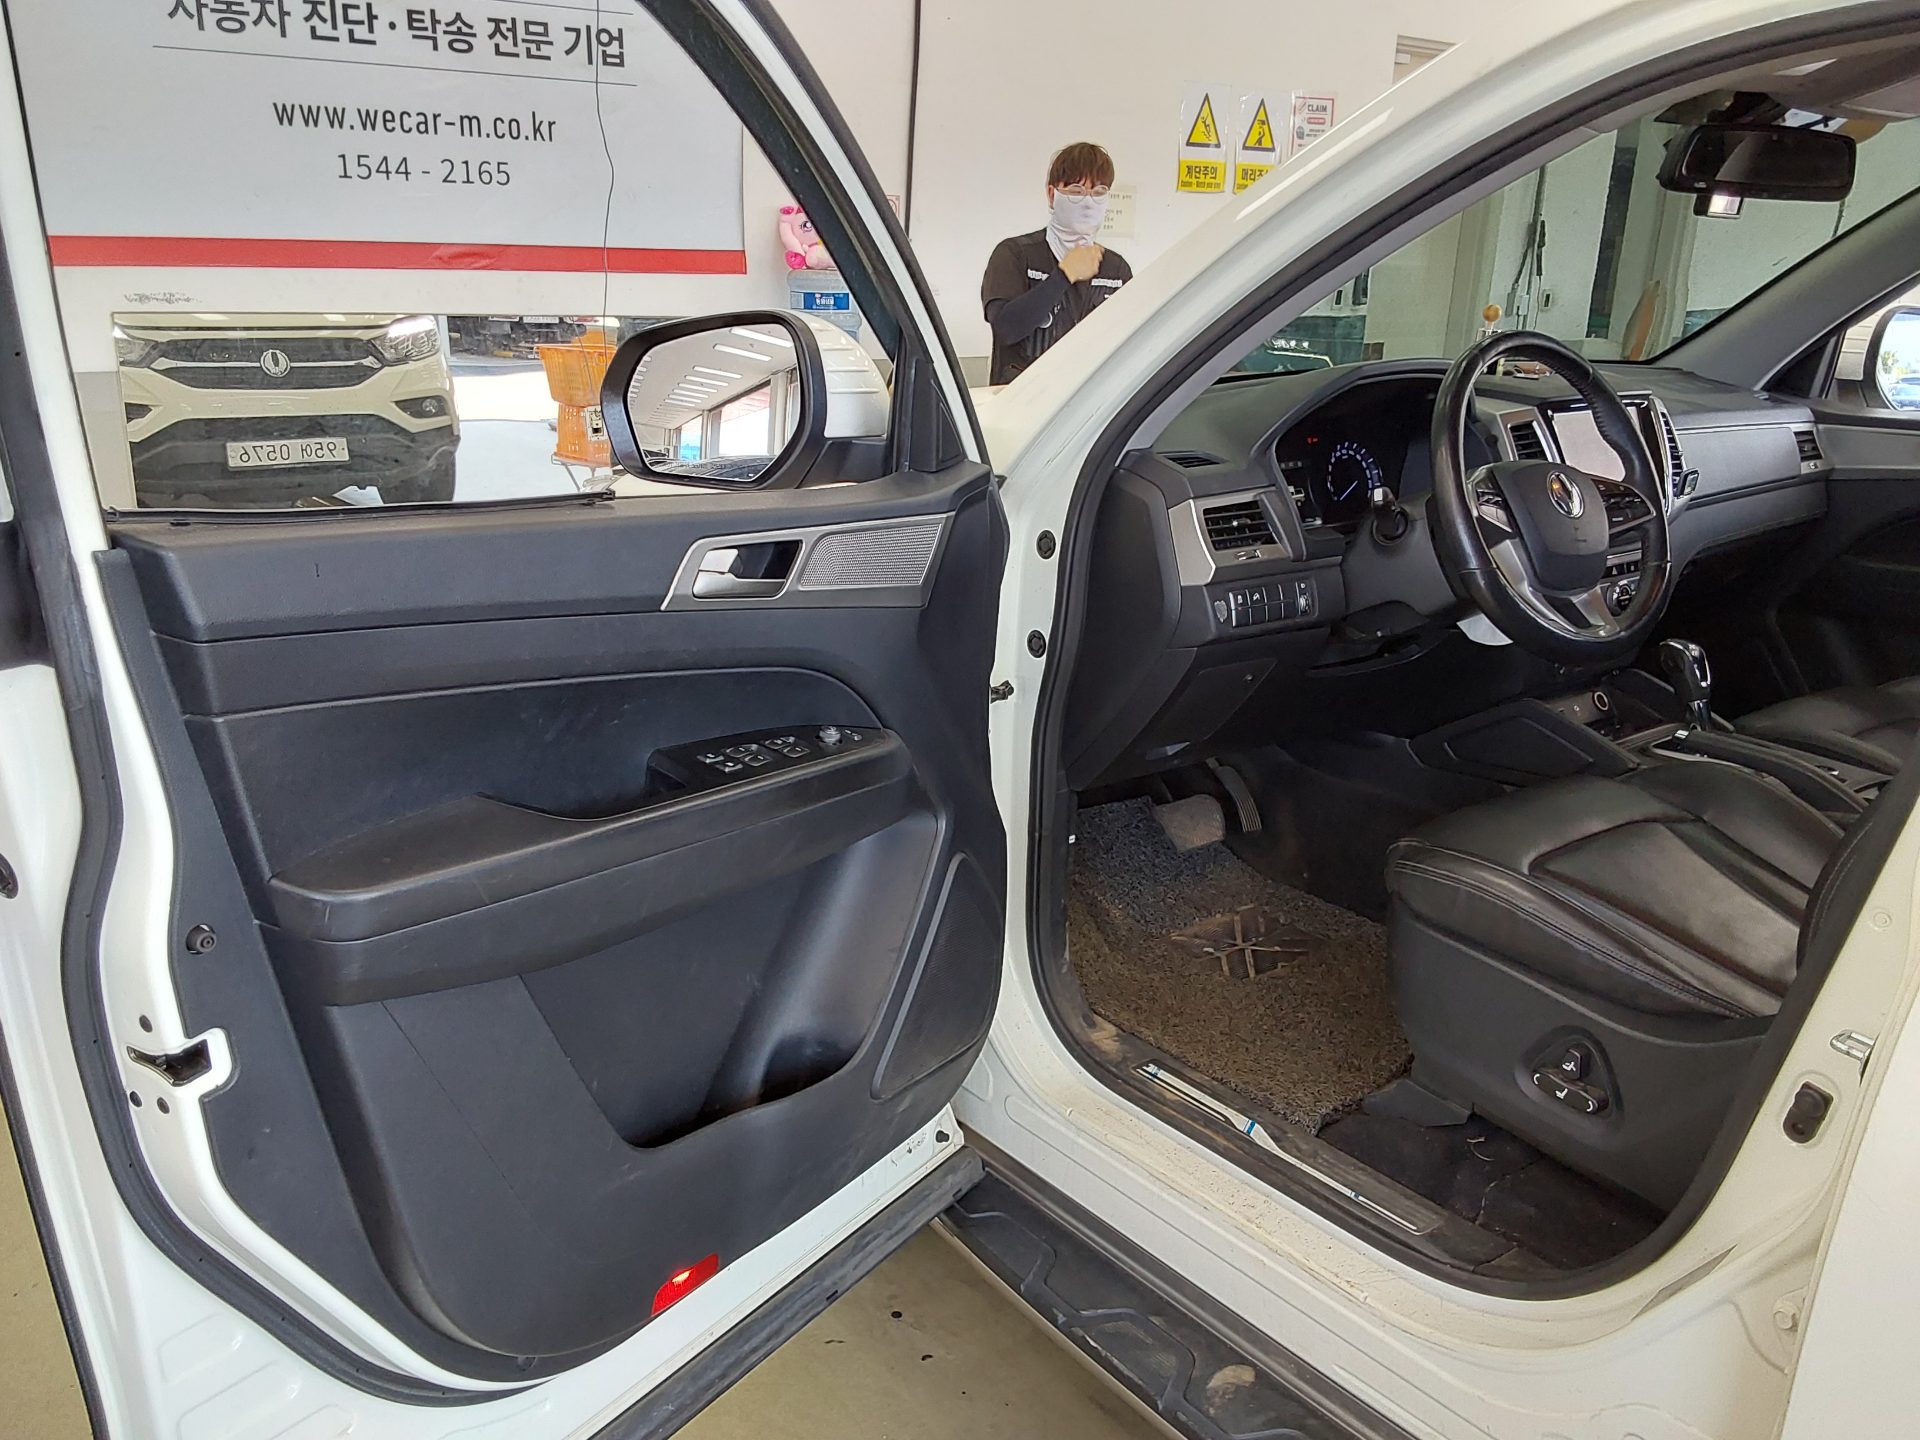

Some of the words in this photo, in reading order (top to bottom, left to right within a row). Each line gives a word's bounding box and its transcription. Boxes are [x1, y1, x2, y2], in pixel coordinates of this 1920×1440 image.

[487, 17, 554, 61] 전문
[564, 25, 625, 68] 기업
[1307, 104, 1328, 112] CLAIM
[272, 102, 557, 142] www.wecar-m.co.kr
[1185, 165, 1218, 180] 계단주의
